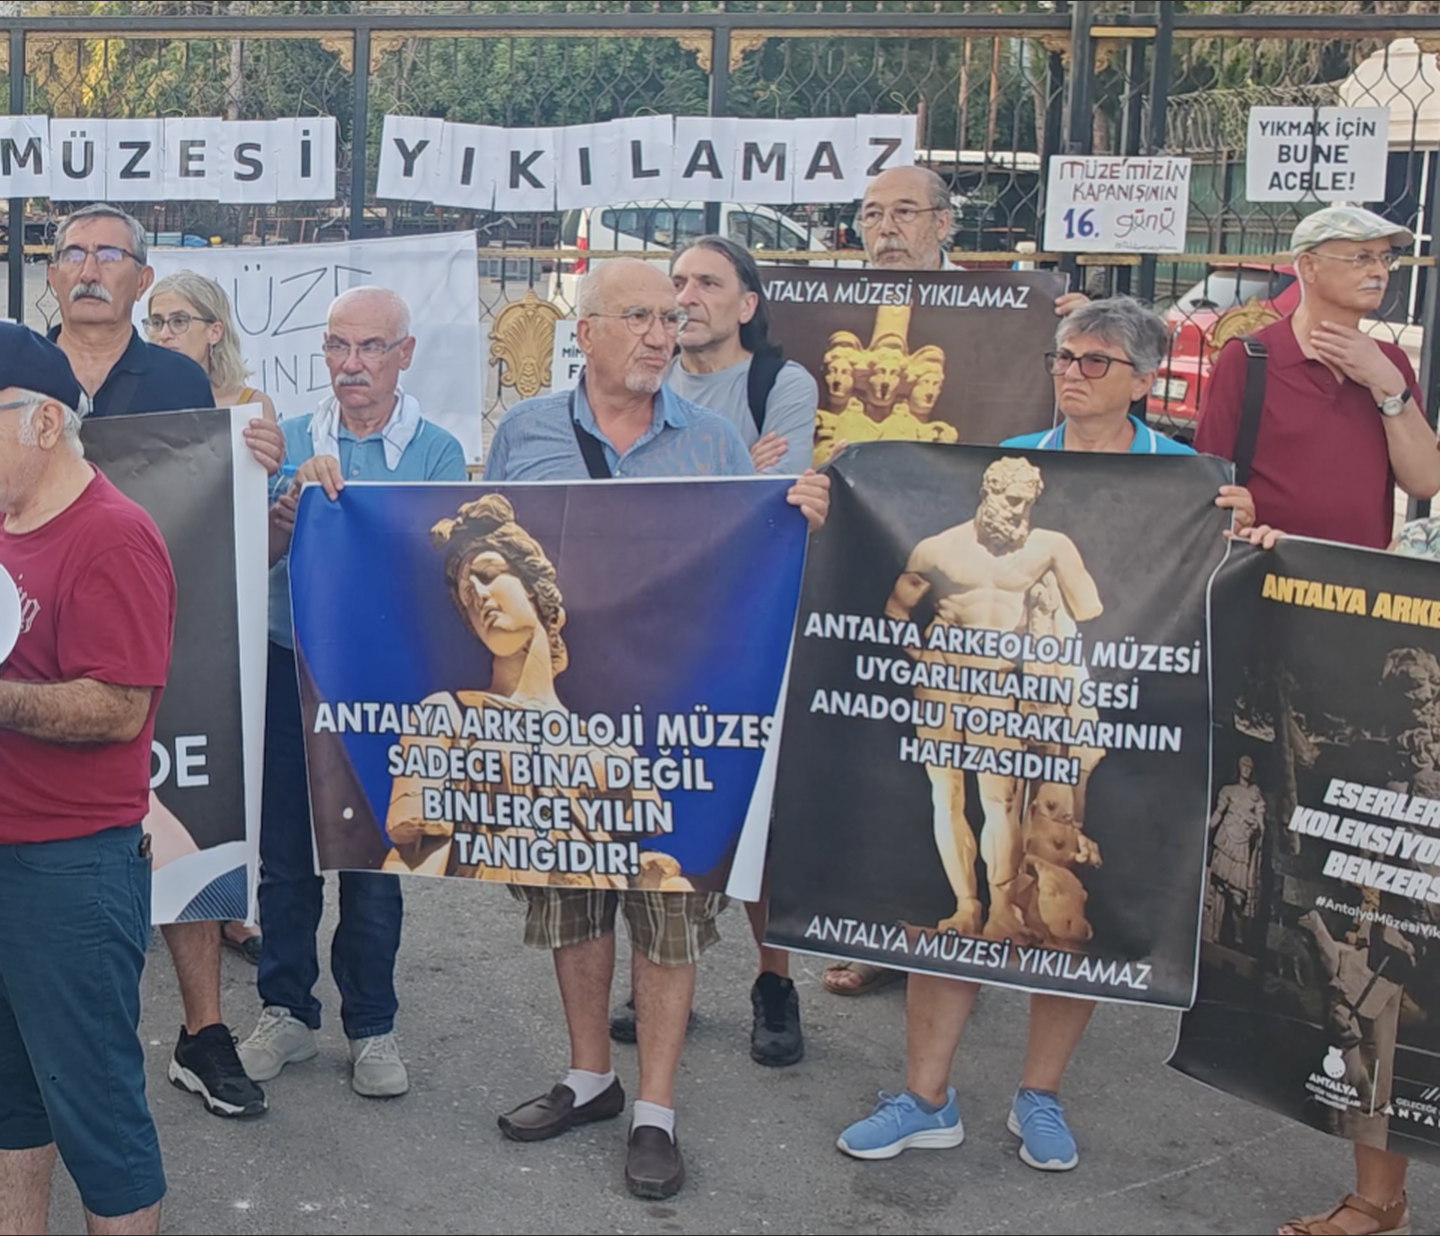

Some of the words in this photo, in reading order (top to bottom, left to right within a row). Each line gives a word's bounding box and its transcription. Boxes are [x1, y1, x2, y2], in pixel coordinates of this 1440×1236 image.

[1259, 119, 1330, 138] YIKMAK
[1335, 116, 1377, 140] İÇİN
[0, 127, 312, 181] MÜZESİ
[392, 136, 903, 189] YIKILAMAZ
[1277, 144, 1309, 164] BU
[1314, 145, 1349, 164] NE
[1072, 182, 1178, 202] KAPANIŞININ
[1268, 171, 1356, 191] ACELE!
[1063, 208, 1100, 239] 16.
[833, 277, 913, 307] MÜZESİ
[918, 283, 1030, 308] YIKILAMAZ
[1262, 573, 1366, 616] ANTALYA
[804, 612, 921, 649] ANTALYA
[928, 624, 1083, 667] ARKEOLOJİ
[1091, 637, 1201, 675] MÜZESİ
[855, 655, 1072, 705] UYGARLIKLARIN
[1078, 677, 1139, 711] SESİ
[314, 702, 454, 737] ANTALYA
[462, 705, 644, 747] ARKEOLOJİ
[810, 689, 944, 728] ANADOLU
[952, 706, 1182, 752] TOPRAKLARININ
[387, 745, 501, 784] SADECE
[511, 746, 596, 790] BİNA
[607, 747, 714, 792] DEĞİL
[899, 737, 1081, 785] HAFIZASIDIR!
[423, 778, 571, 831] BİNLERCE
[580, 798, 674, 833] YILIN
[453, 830, 640, 875] TANIĞIDIR!
[1288, 805, 1440, 867] KOLEKSİYO
[805, 915, 909, 954] ANTALYA
[915, 930, 1010, 969] MÜZESİ
[1016, 946, 1152, 990] YIKILAMAZ
[1308, 1072, 1359, 1098] ANTALYA
